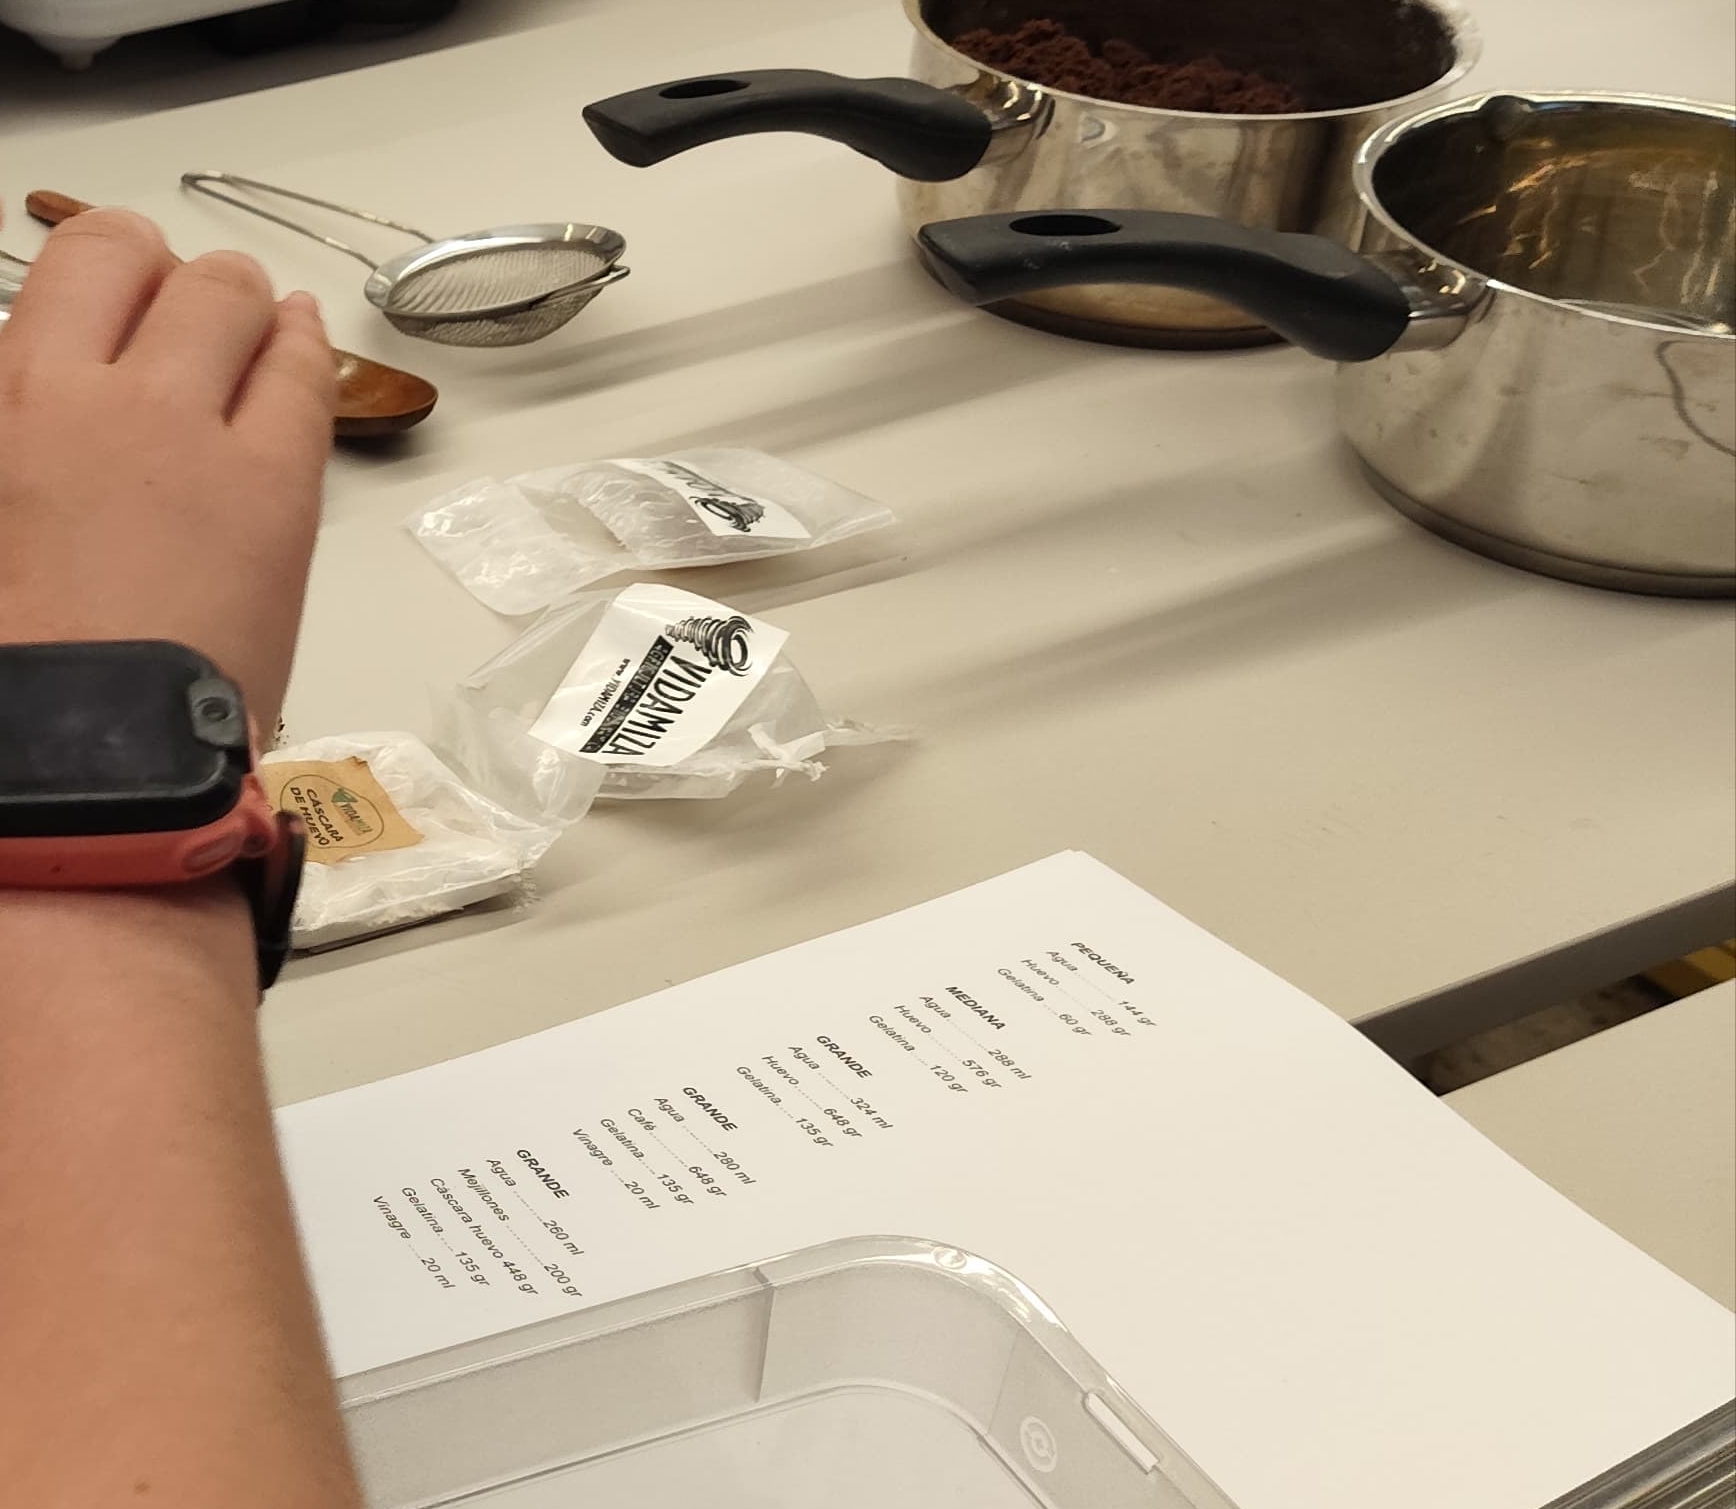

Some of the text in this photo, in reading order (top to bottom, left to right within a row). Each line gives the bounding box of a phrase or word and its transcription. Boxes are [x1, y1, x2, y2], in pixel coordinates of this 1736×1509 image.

[601, 655, 712, 756] VIDAMIZA
[290, 787, 330, 846] DE HUEVO
[997, 967, 1092, 1037] Gelatina 60 gr
[1021, 958, 1131, 1037] Huevo 288 gr
[1046, 950, 1157, 1028] Agua 144 gr
[1070, 942, 1136, 985] PEQUEÑA
[894, 1004, 1002, 1090] Huevo 576 gr
[919, 994, 1032, 1080] Agua 288 ml
[945, 986, 1006, 1030] MEDIANA
[788, 1045, 894, 1130] Agua 324 ml
[816, 1034, 873, 1078] GRANDE
[868, 1014, 968, 1094] Gelatina 120 gr
[682, 1086, 739, 1132] GRANDE
[736, 1065, 834, 1148] Gelatina 135 gr
[761, 1055, 863, 1139] Huevo 648 gr
[516, 1149, 570, 1199] GRANDE
[572, 1128, 661, 1210] Vinagre 20 ml
[600, 1118, 695, 1206] Gelatina 135 gr
[627, 1108, 727, 1198] Café 648 gr
[653, 1097, 758, 1185] Agua 280 ml
[372, 1195, 456, 1289] Vinagre 20 ml
[401, 1187, 491, 1287] Gelatina 135 gr
[458, 1167, 583, 1298] Mejillones 200 gr
[486, 1158, 585, 1256] Agua 260 ml
[468, 1224, 504, 1259] huevo
[501, 1261, 527, 1282] 448
[518, 1282, 539, 1297] gr
